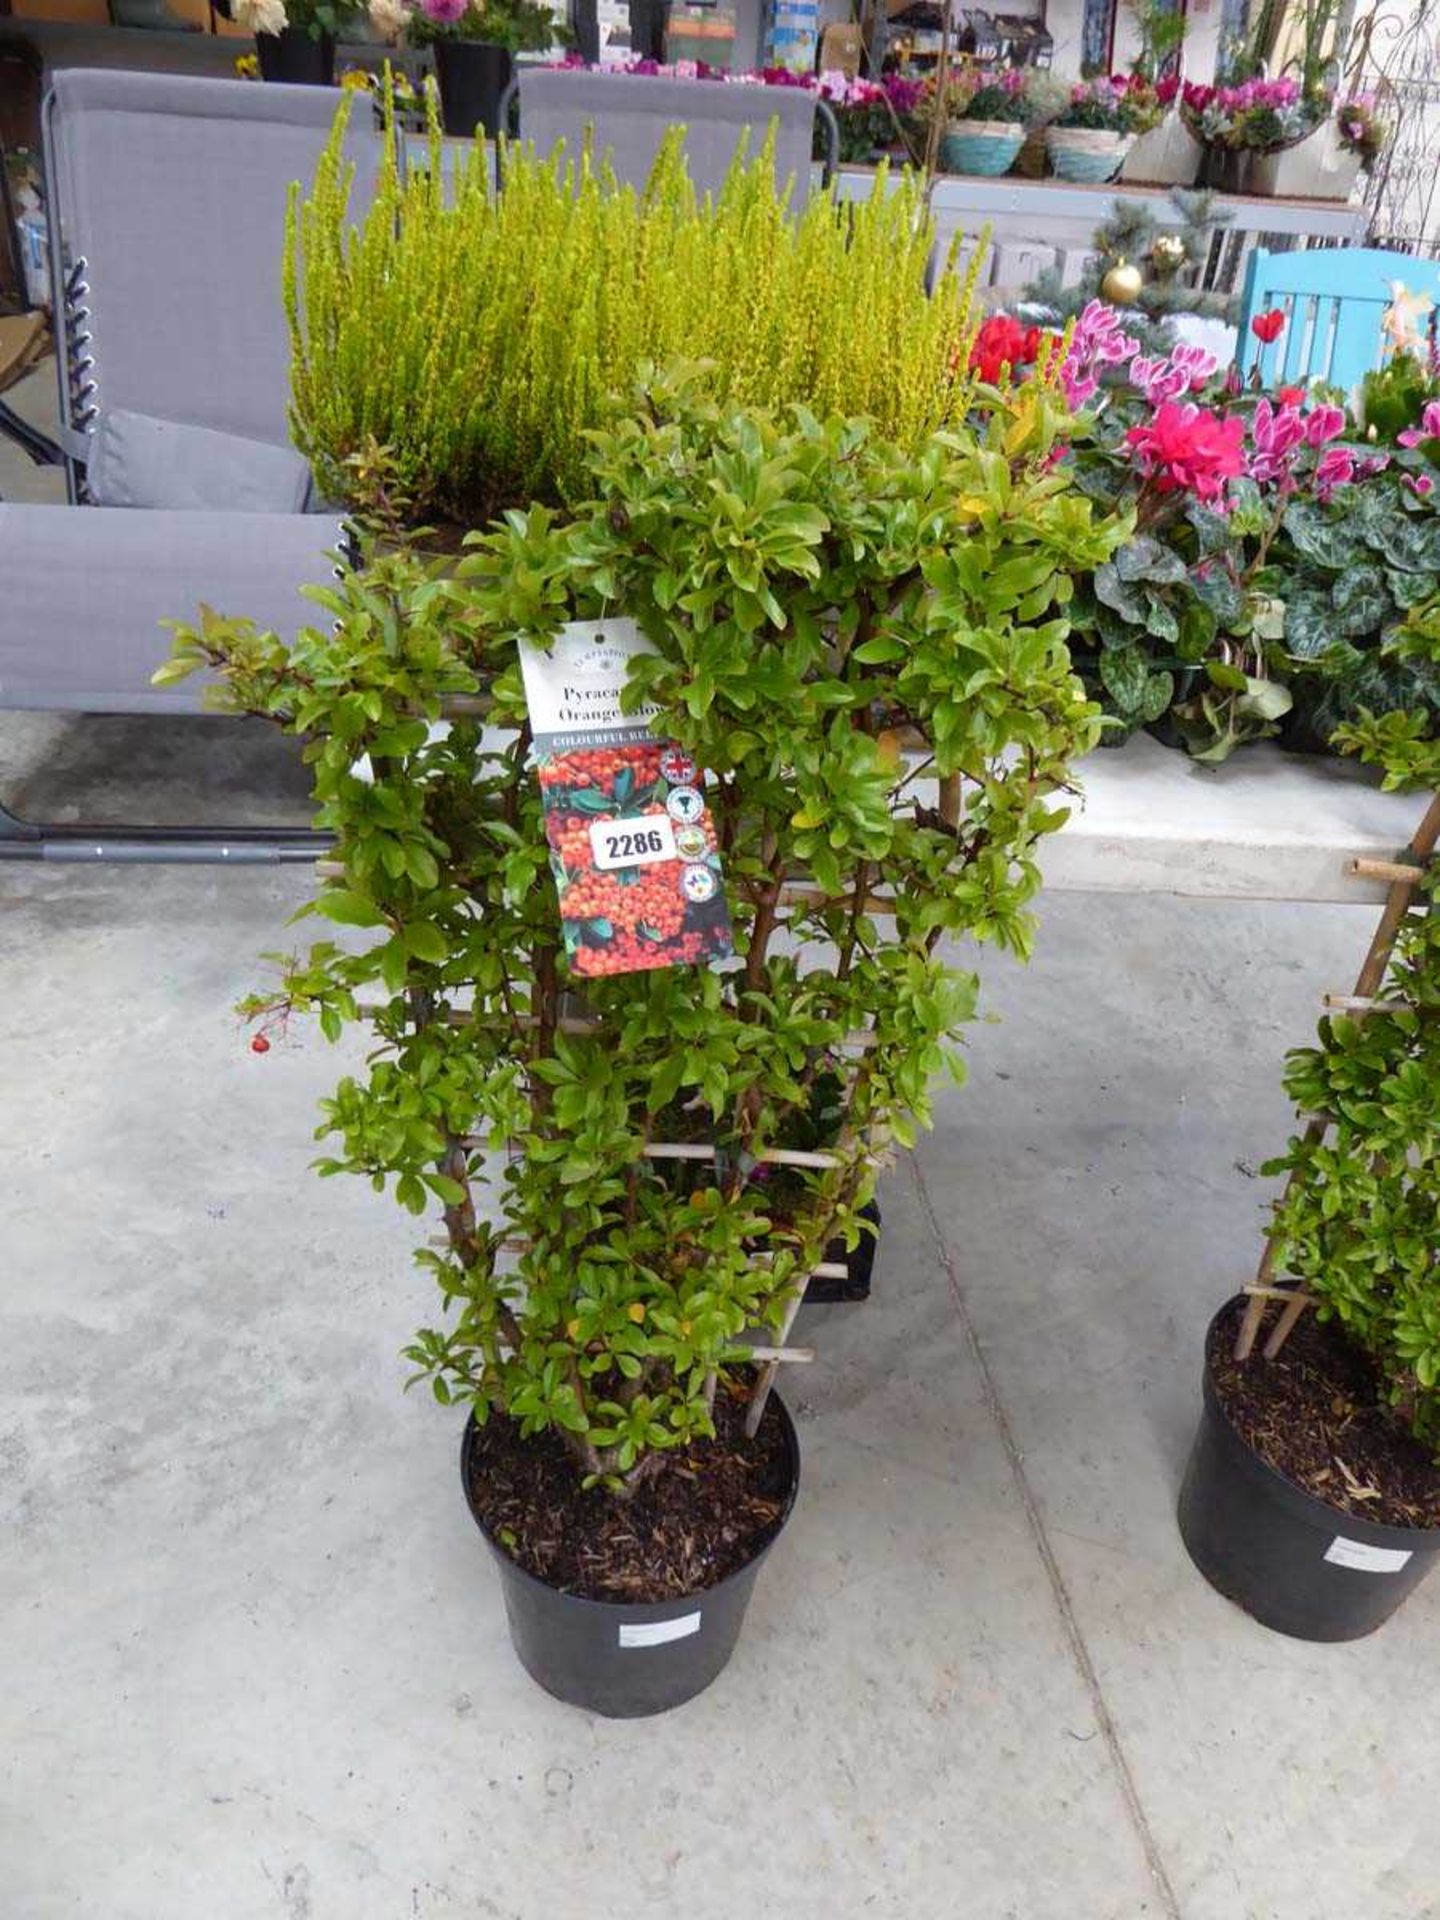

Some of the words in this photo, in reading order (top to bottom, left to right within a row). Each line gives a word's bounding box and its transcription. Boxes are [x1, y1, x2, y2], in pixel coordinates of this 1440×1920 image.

[559, 708, 619, 723] Orange
[552, 732, 627, 747] COLOURFUL
[606, 830, 662, 858] 2286
